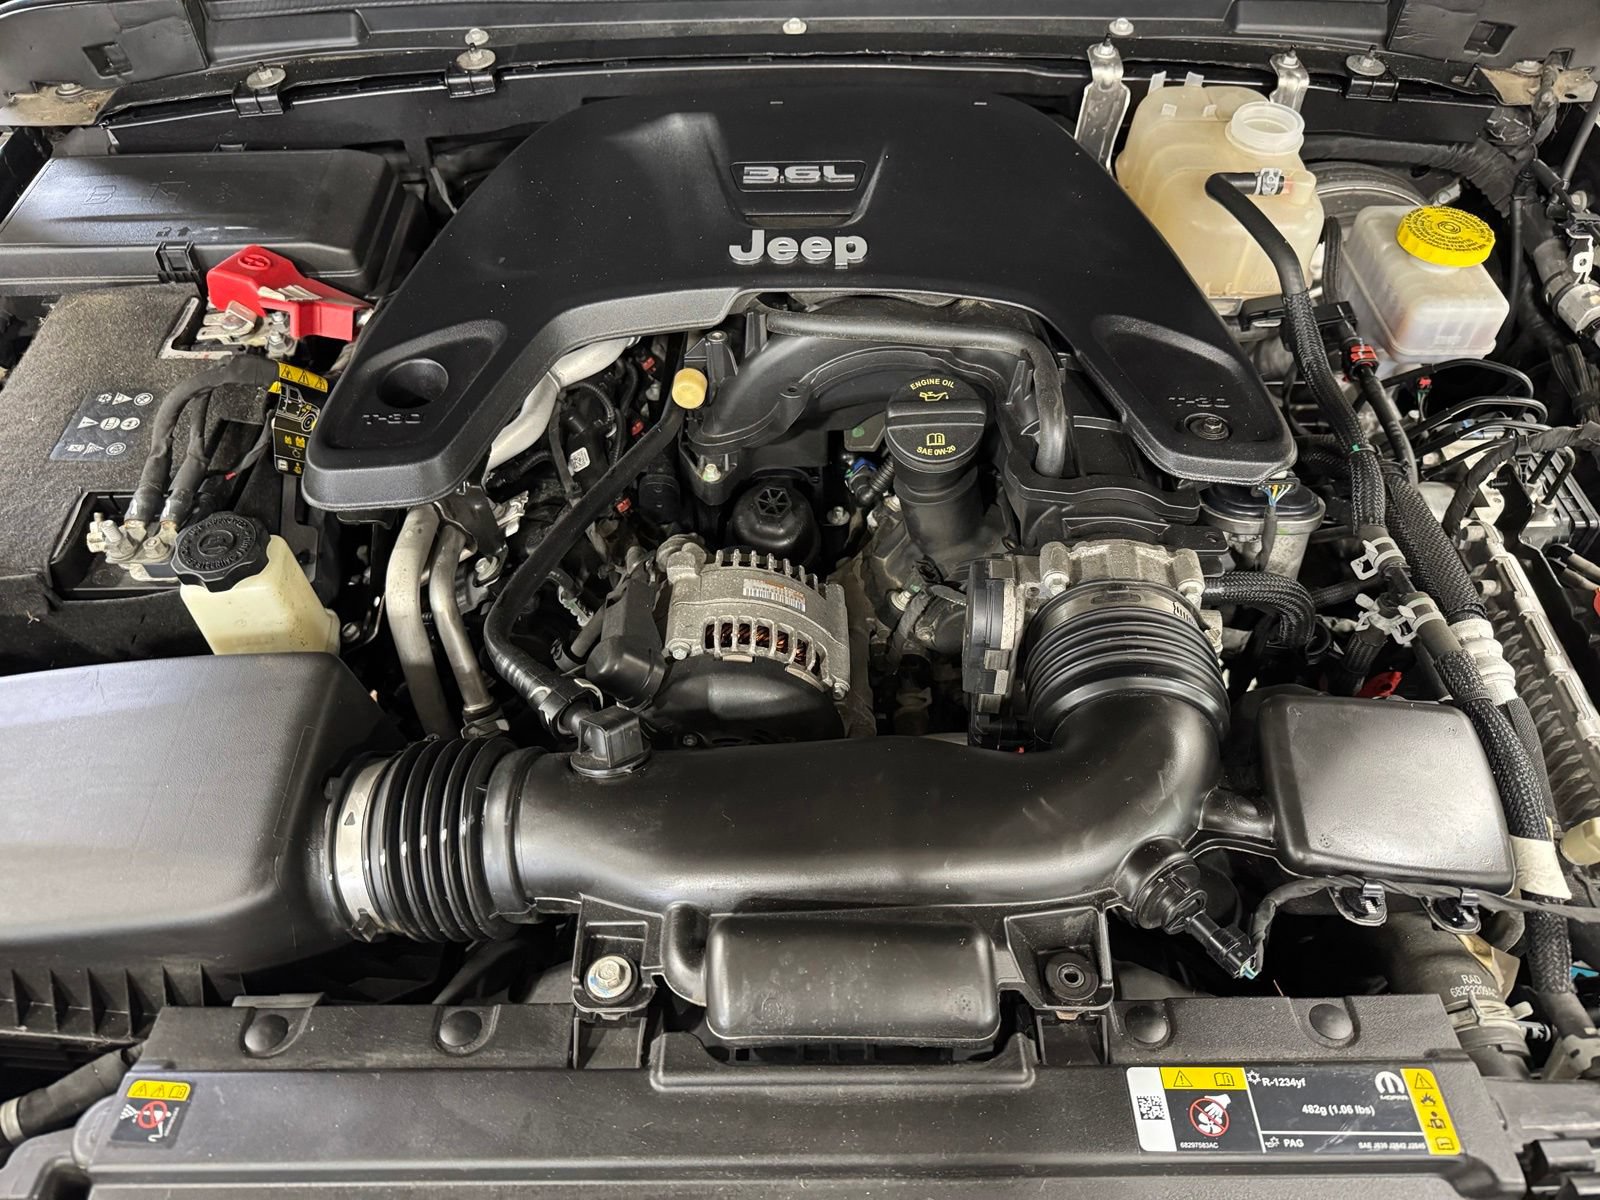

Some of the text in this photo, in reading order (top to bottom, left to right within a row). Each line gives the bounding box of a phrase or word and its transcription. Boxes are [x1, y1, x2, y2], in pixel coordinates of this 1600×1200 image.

[742, 165, 856, 184] 3.6L
[728, 229, 868, 269] Jeep
[909, 378, 955, 390] ENGINE OIL
[916, 445, 956, 456] SAE 0W-20
[1461, 975, 1482, 985] RAD
[1262, 1077, 1306, 1088] R-1234yf
[1302, 1105, 1376, 1116] 482g (1.06 lbs)
[1283, 1139, 1305, 1148] PAG
